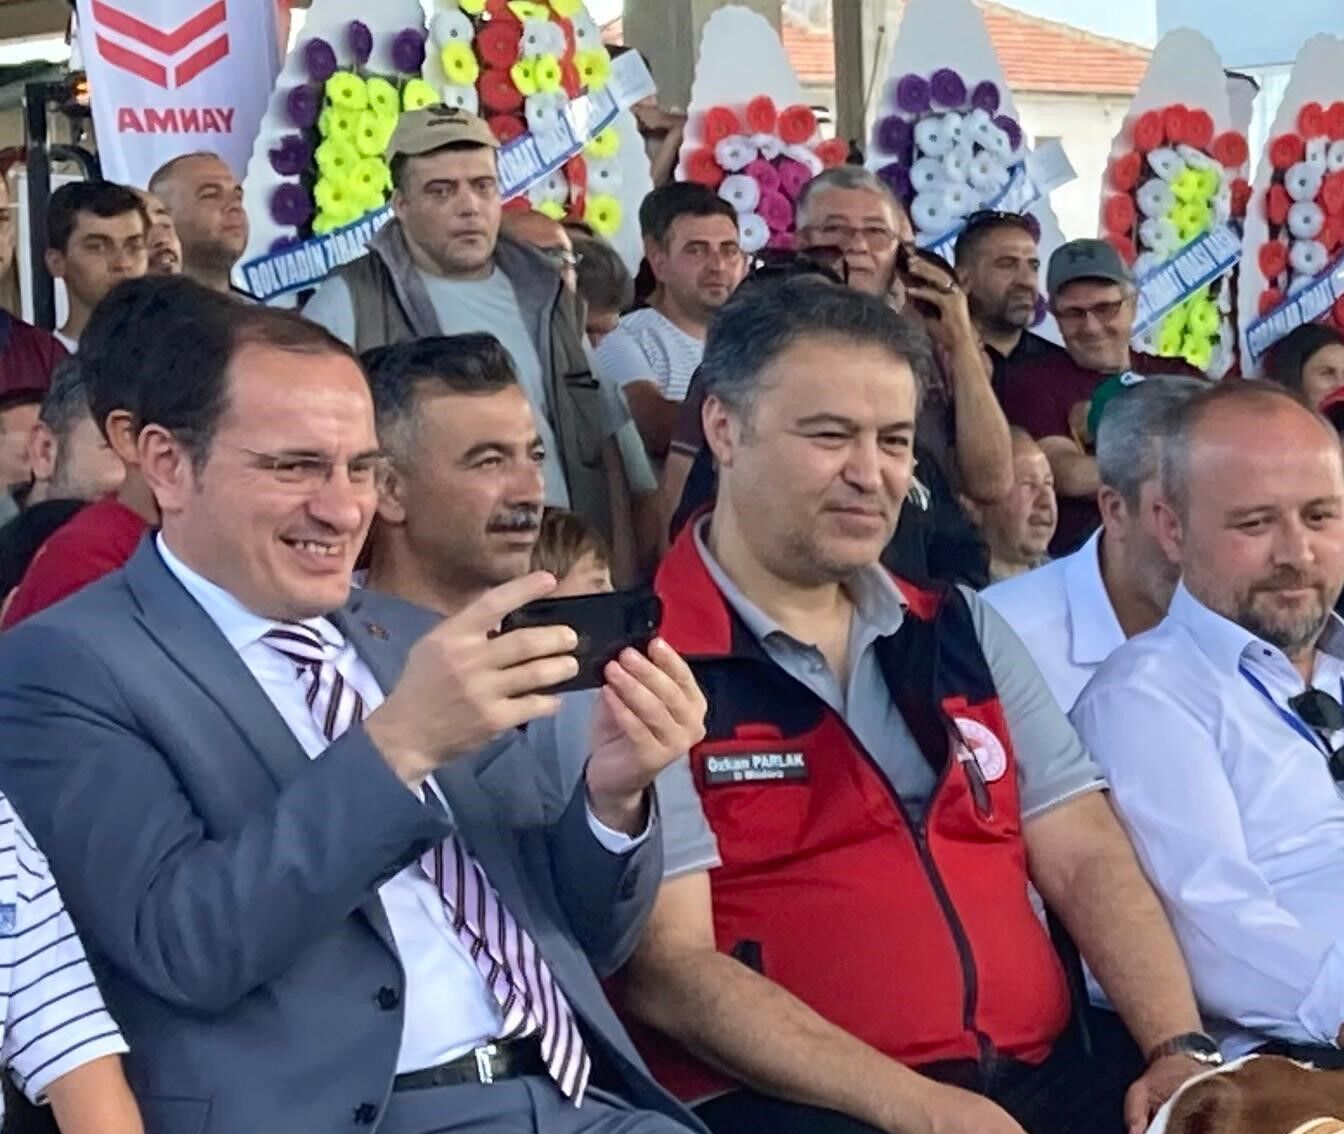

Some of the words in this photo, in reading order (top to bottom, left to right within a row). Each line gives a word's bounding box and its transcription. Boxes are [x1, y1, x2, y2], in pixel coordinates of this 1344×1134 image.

[248, 241, 328, 298] BOLVADİN
[708, 756, 750, 773] Özkan
[752, 753, 804, 769] PARLAK
